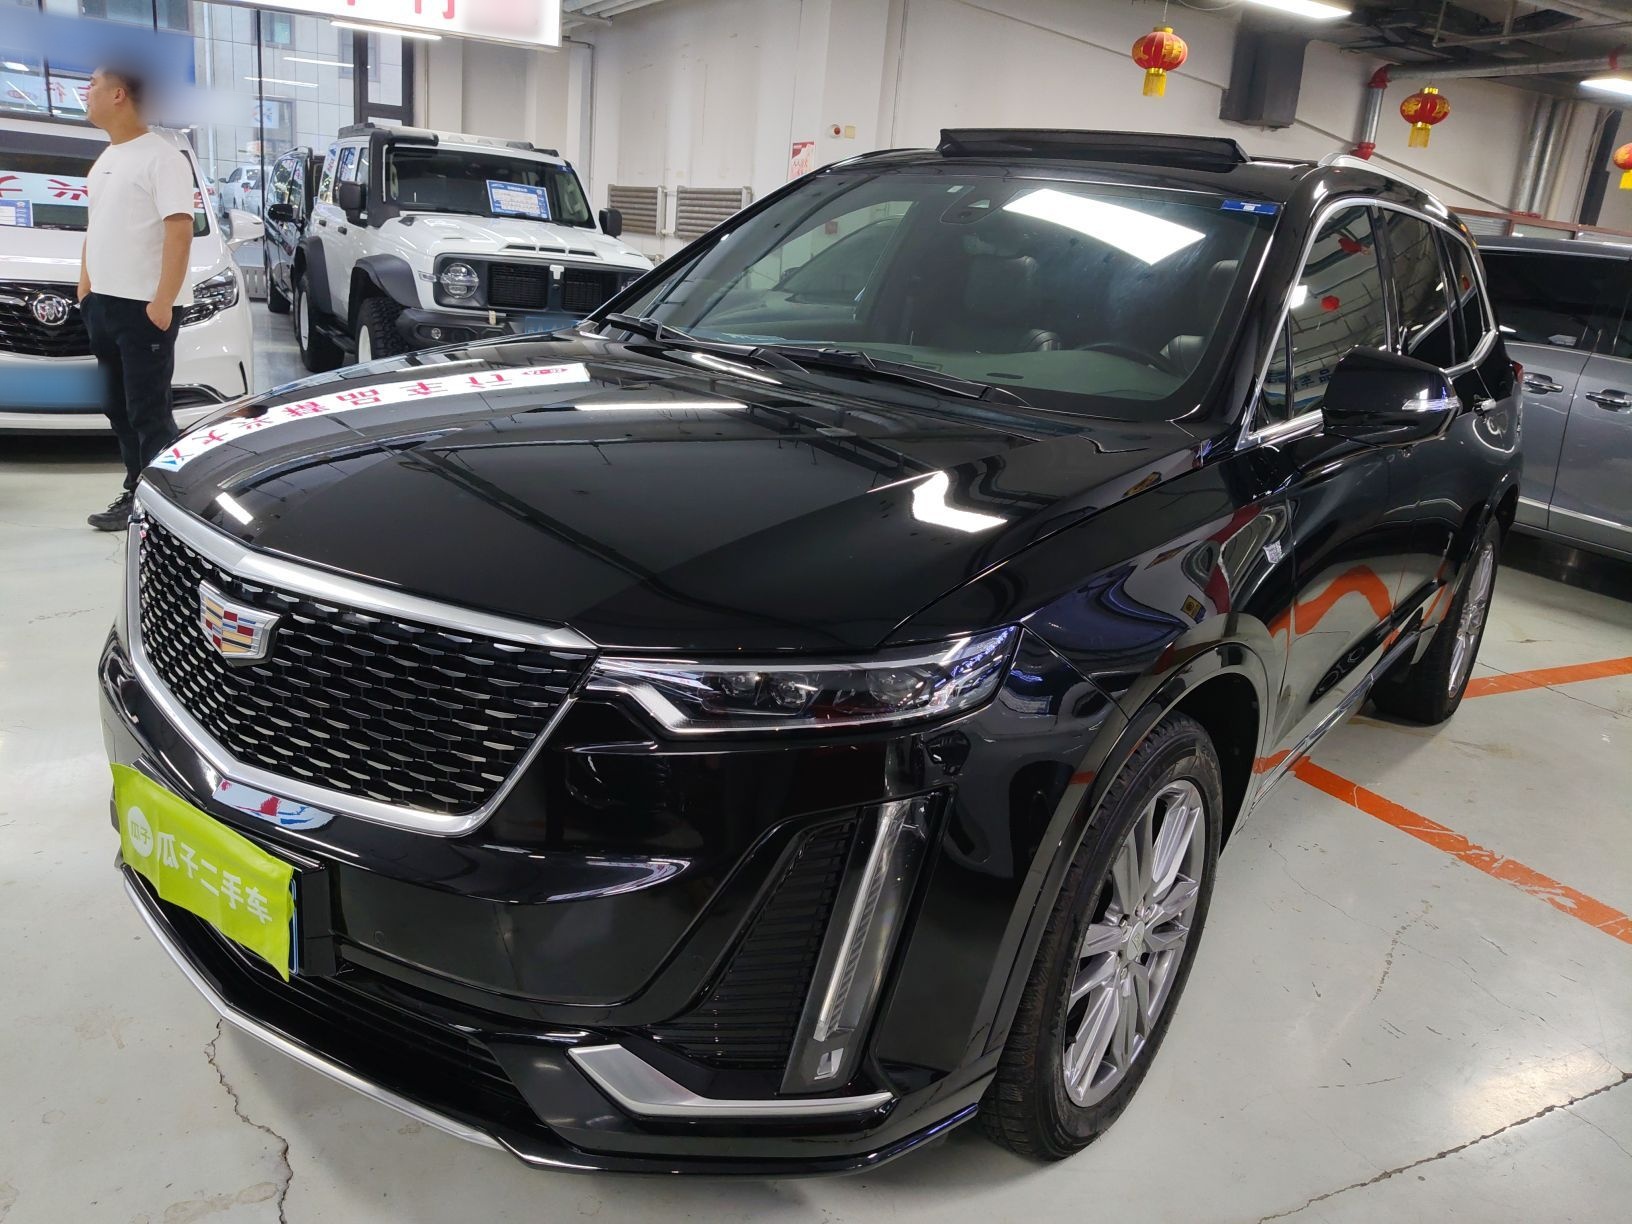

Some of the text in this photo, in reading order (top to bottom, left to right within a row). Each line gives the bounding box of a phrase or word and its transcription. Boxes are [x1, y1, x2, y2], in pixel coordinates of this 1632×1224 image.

[131, 822, 151, 845] 瓜子
[158, 833, 272, 924] 瓜子二手车
